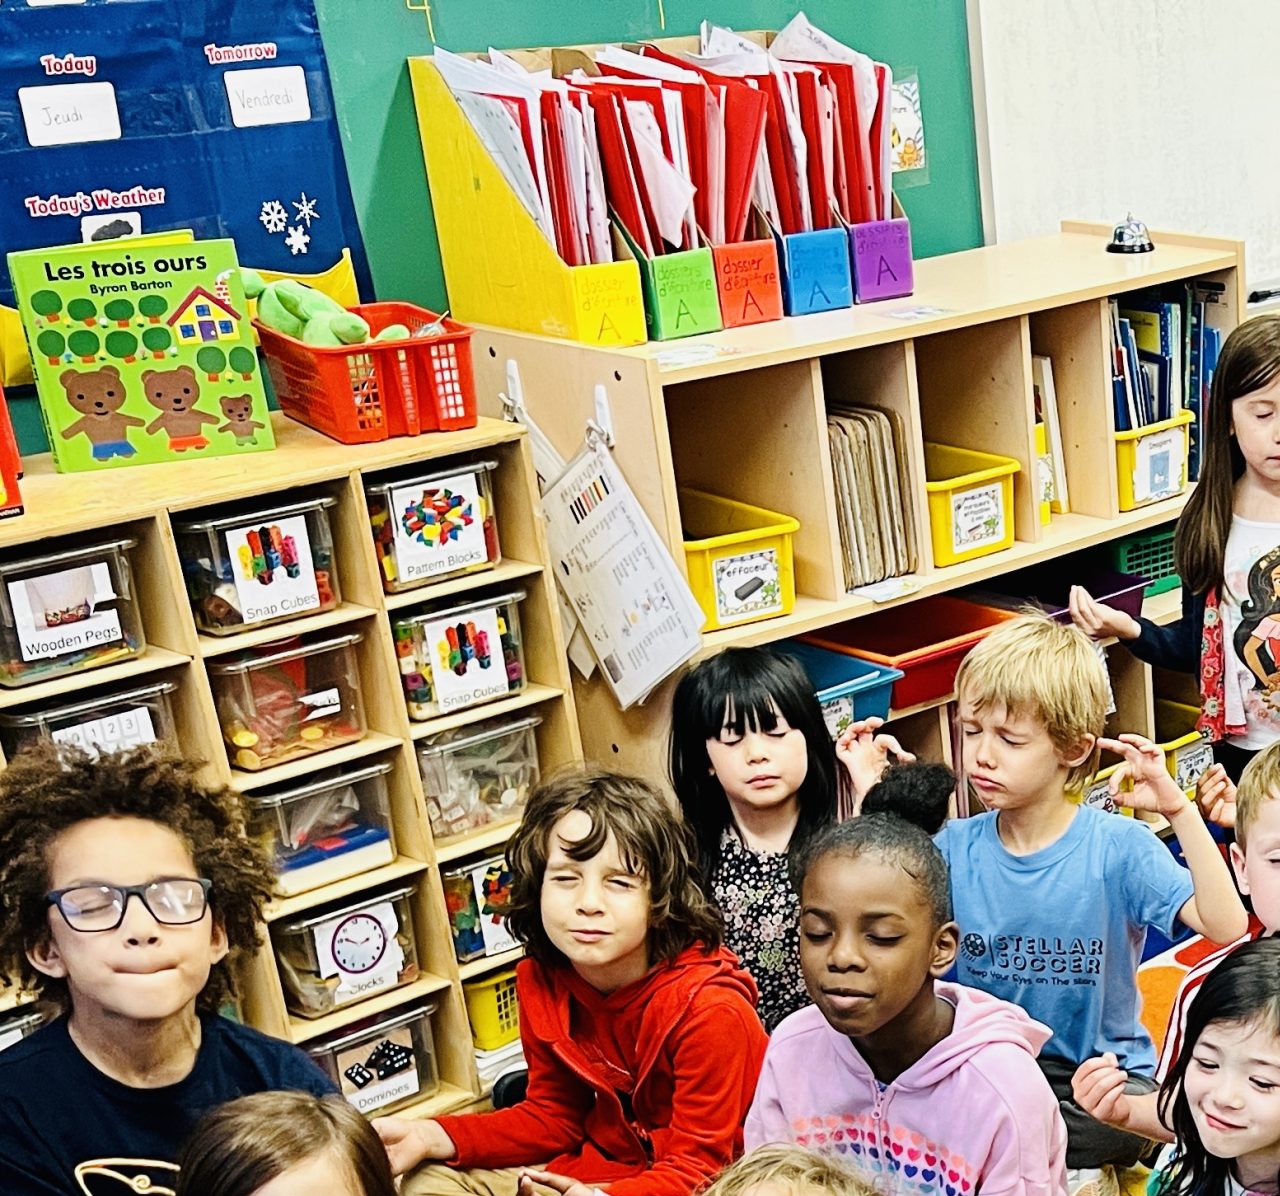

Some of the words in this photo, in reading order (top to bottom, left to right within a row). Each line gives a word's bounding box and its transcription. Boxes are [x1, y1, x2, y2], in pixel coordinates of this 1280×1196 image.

[44, 56, 94, 74] Today
[207, 45, 275, 62] Tomorrow
[236, 88, 294, 110] Vendredi
[41, 106, 83, 126] Jeudi
[28, 196, 91, 214] Today's
[94, 190, 163, 208] Weather
[44, 262, 85, 281] Les
[92, 255, 146, 278] trois
[154, 255, 207, 273] ours
[723, 256, 764, 275] dossier
[877, 255, 898, 286] A
[90, 282, 128, 296] Byron
[131, 279, 173, 292] Barton
[809, 280, 831, 307] A
[676, 299, 698, 329] A
[742, 290, 764, 319] A
[598, 313, 622, 340] A
[407, 560, 445, 576] Pattern
[447, 550, 482, 567] Blocks
[726, 563, 769, 577] effaceur
[246, 604, 279, 620] Snap
[281, 592, 318, 611] Cubes
[26, 634, 82, 656] Wooden
[85, 626, 119, 643] Pegs
[443, 692, 472, 709] Snap
[473, 683, 507, 699] Cubes
[994, 935, 1103, 955] STELLAR
[966, 965, 987, 978] Keep
[997, 952, 1100, 974] SOCCER
[358, 1083, 410, 1108] Dominoes
